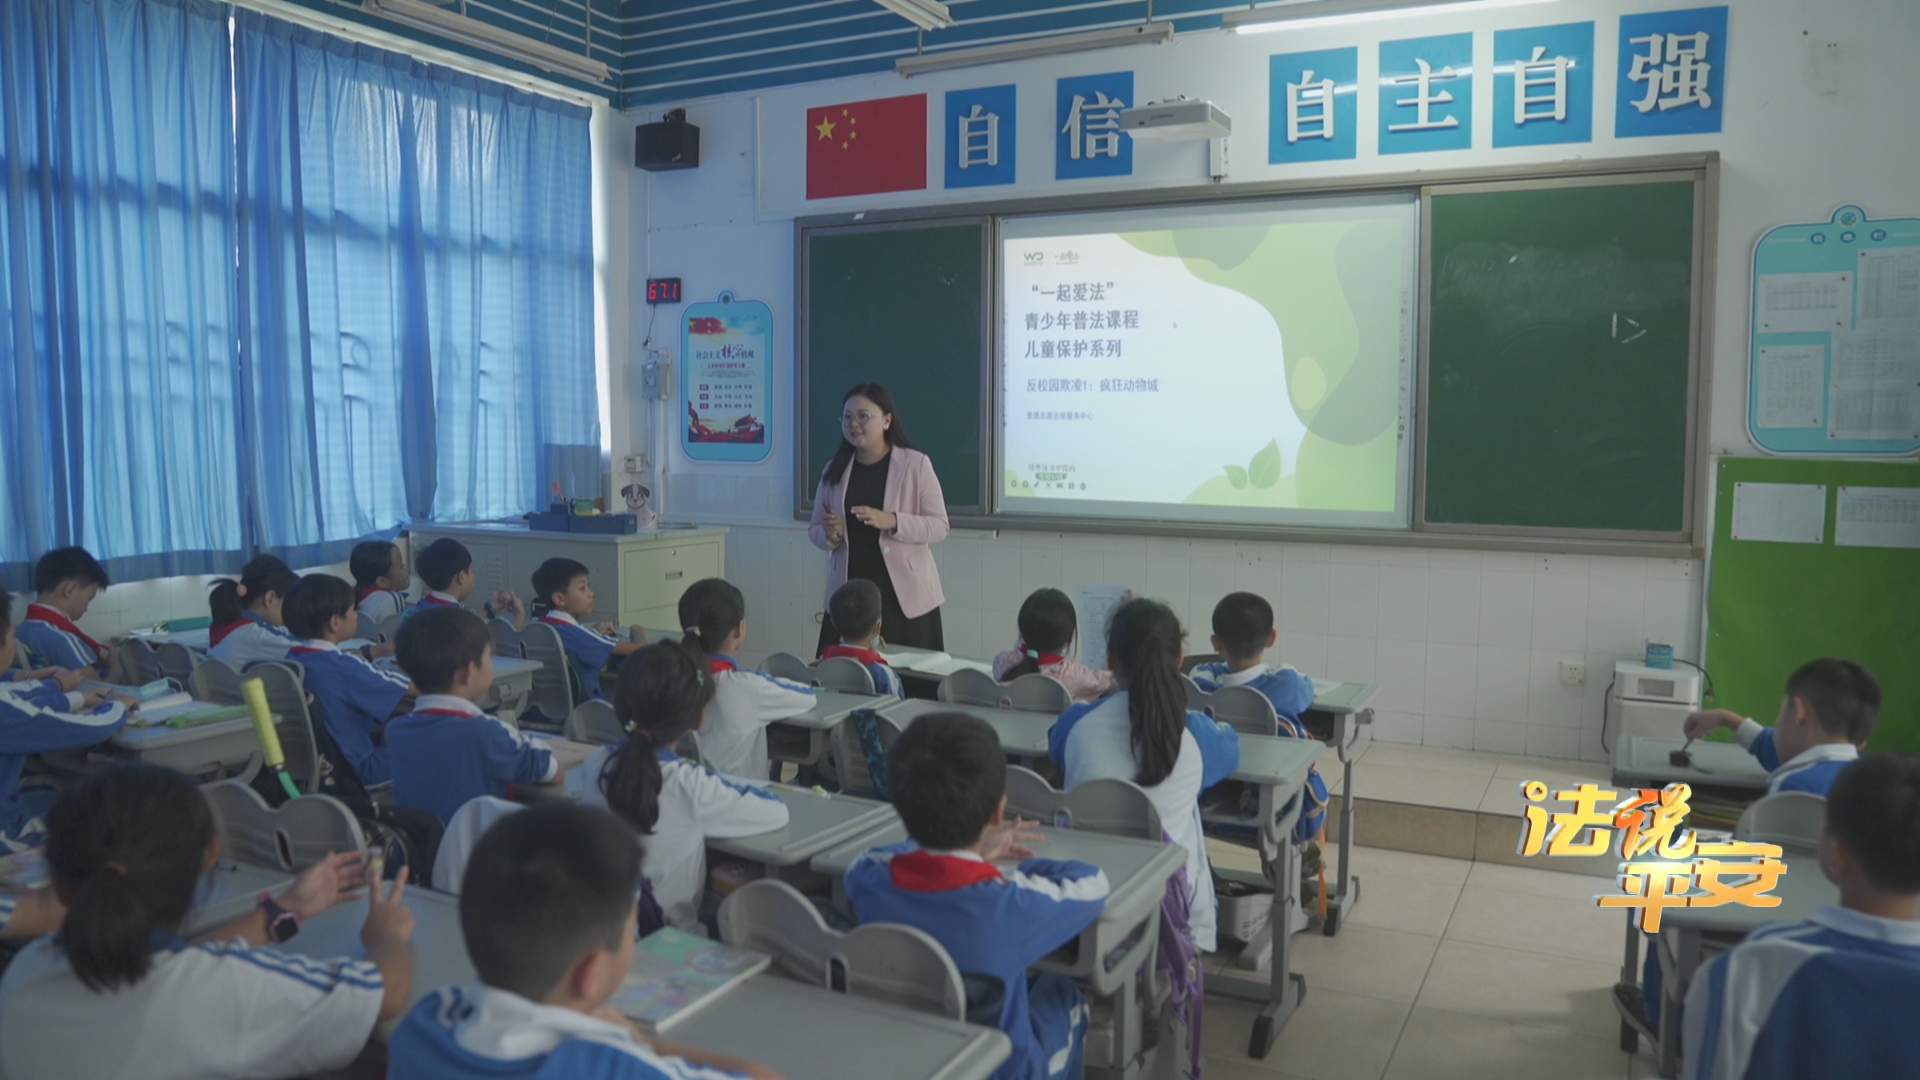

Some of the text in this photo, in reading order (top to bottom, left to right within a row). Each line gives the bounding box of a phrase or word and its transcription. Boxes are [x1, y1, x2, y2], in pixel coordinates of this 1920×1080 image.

[958, 31, 1712, 170] 自信 自主自强
[1031, 282, 1114, 302] “一起爱法”
[1024, 310, 1140, 331] 青少年普法课程
[1024, 339, 1122, 358] 儿童保护系列
